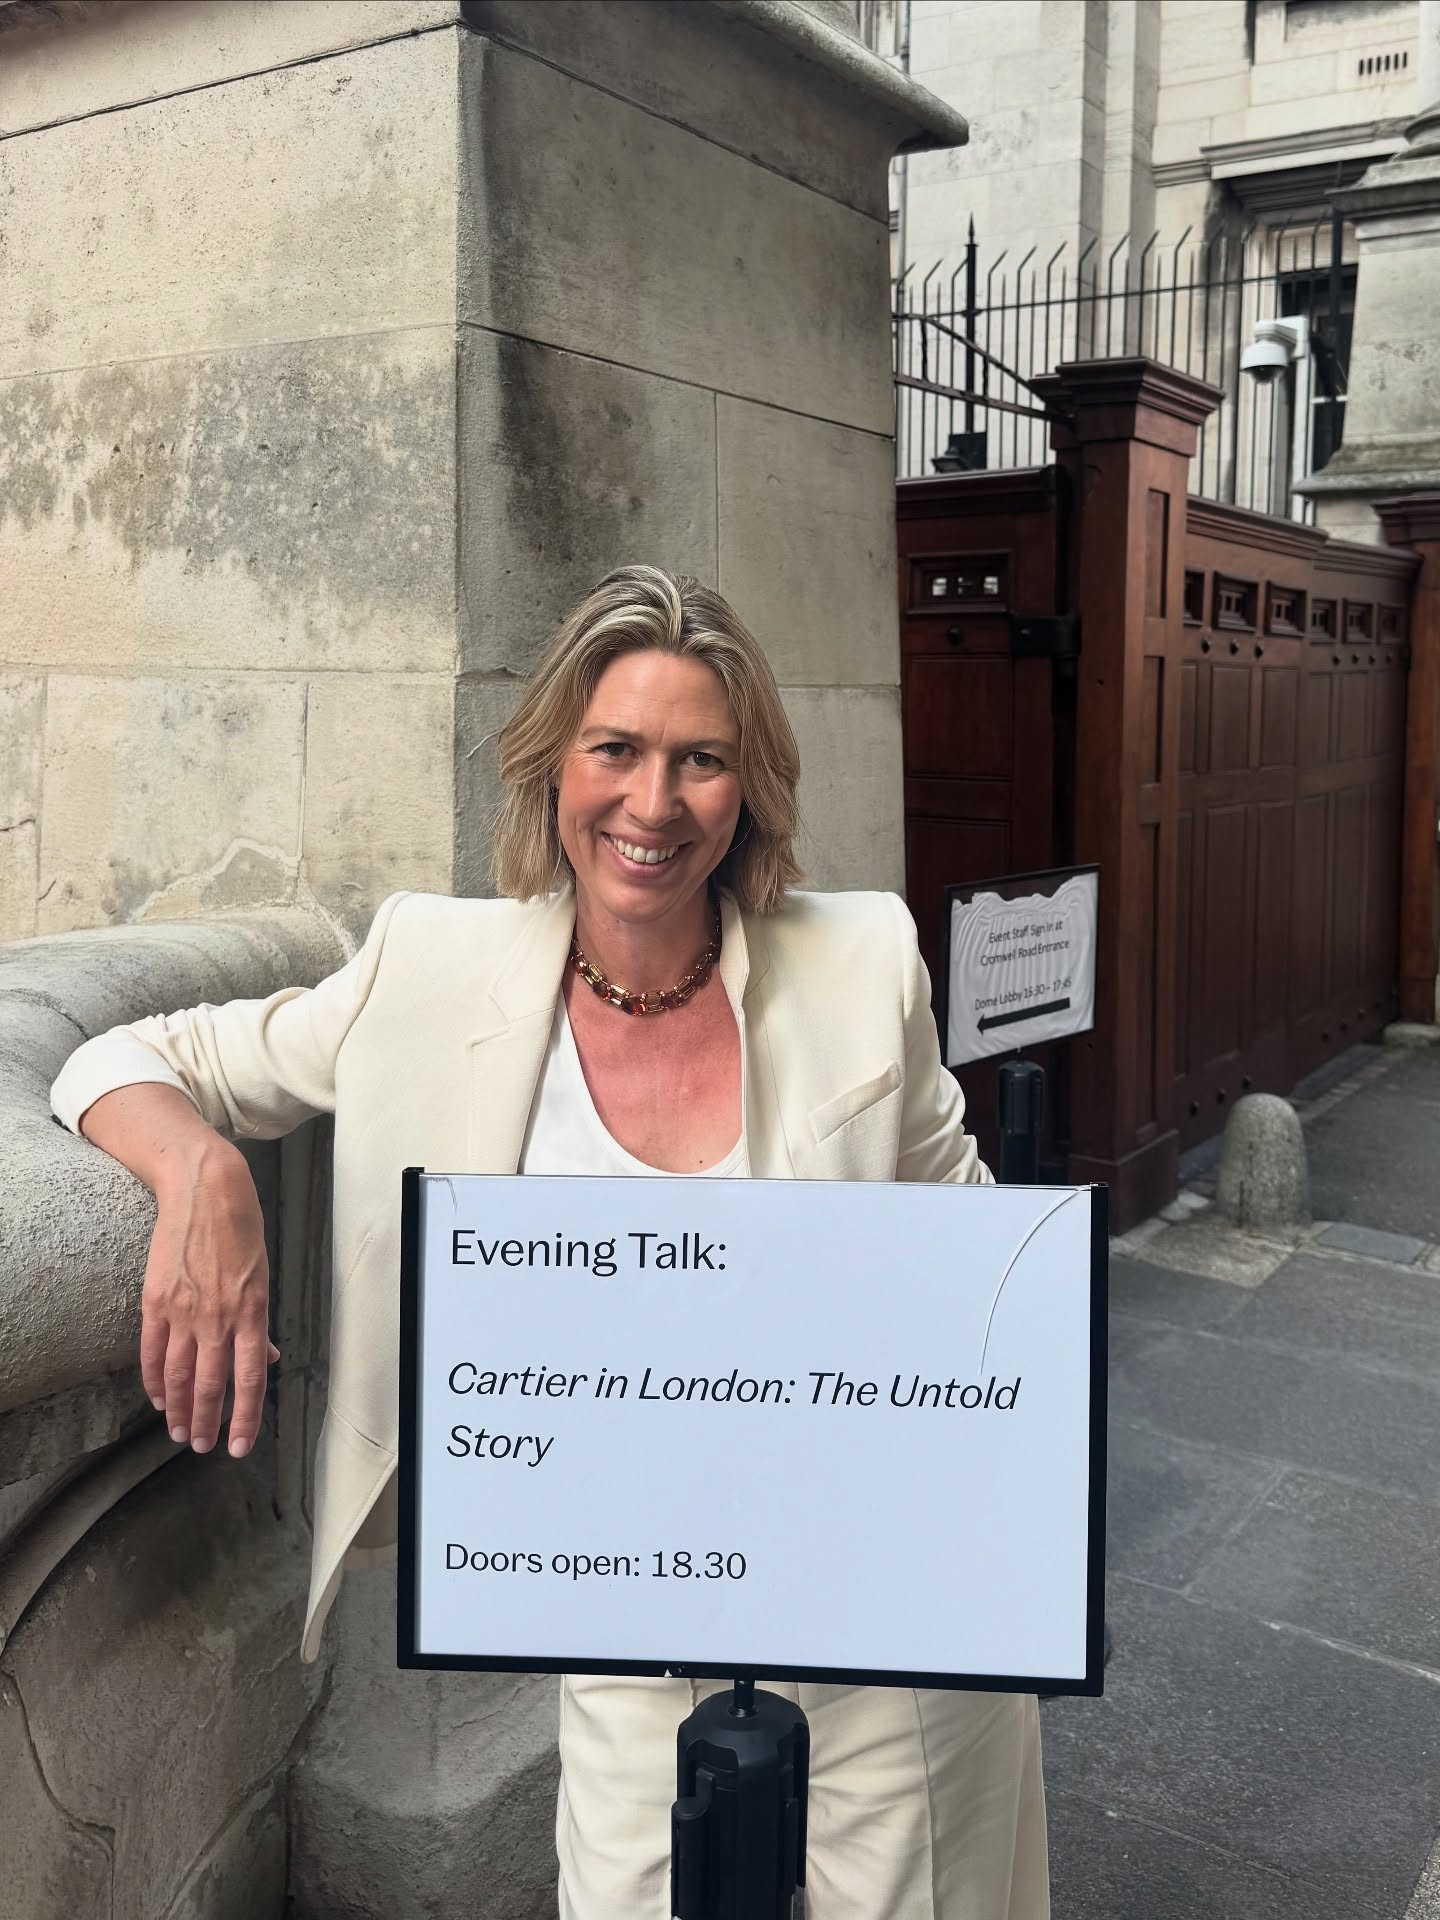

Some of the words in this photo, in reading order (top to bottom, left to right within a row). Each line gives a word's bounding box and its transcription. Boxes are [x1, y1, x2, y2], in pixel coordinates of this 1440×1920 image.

[989, 932, 1011, 944] Event
[1012, 925, 1030, 939] Staff
[1030, 924, 1046, 936] Sign
[1018, 945, 1037, 958] Road
[1038, 941, 1069, 954] Entrance
[975, 998, 998, 1010] Dome
[999, 989, 1023, 1005] Lobby
[451, 1229, 618, 1278] Evening
[627, 1231, 727, 1271] Talk:
[448, 1362, 588, 1398] Cartier
[594, 1367, 629, 1399] in
[638, 1367, 797, 1404] London:
[808, 1371, 879, 1407] The
[889, 1374, 1022, 1410] Untold
[446, 1424, 555, 1468] Story
[445, 1543, 543, 1574] Doors
[551, 1553, 641, 1581] open:
[651, 1550, 747, 1580] 18.30
